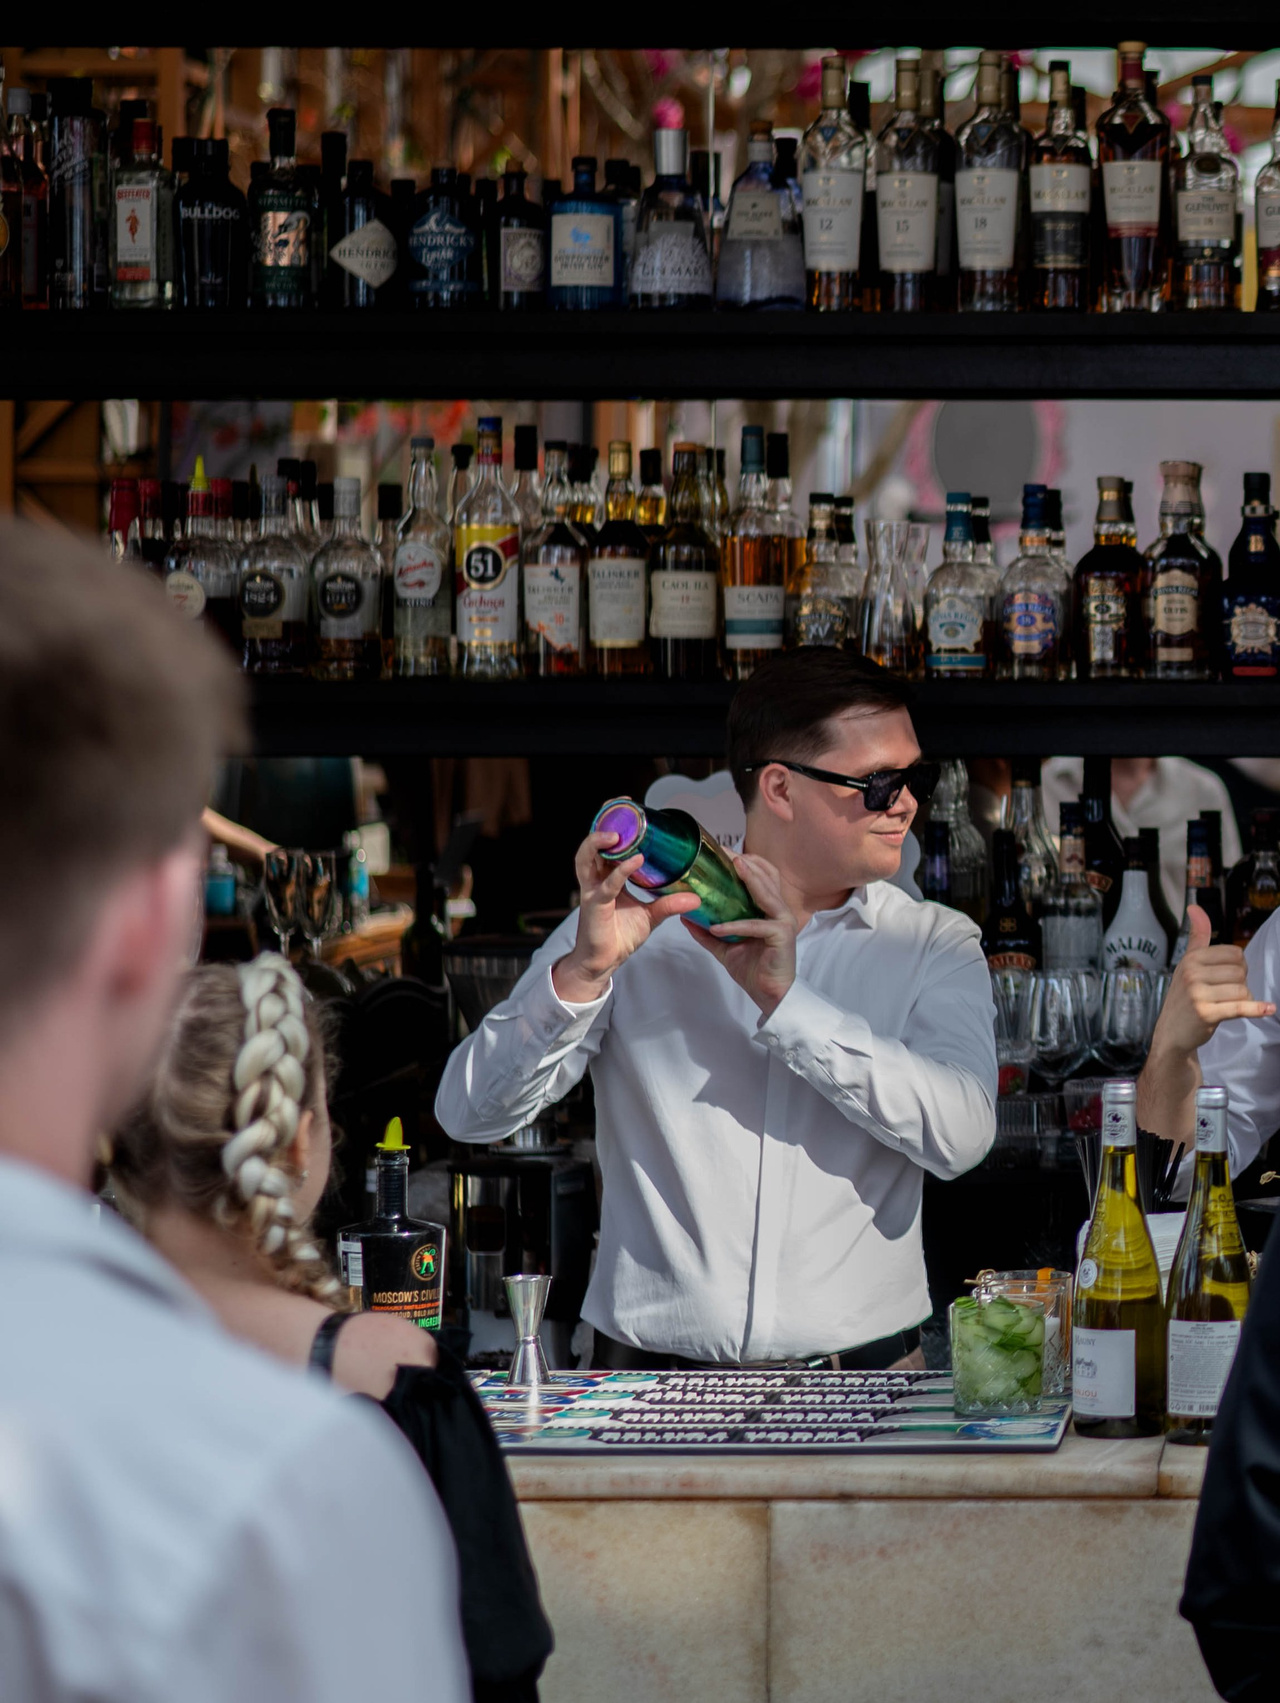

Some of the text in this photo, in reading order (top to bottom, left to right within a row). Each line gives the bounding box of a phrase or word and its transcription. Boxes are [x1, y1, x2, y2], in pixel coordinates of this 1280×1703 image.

[181, 205, 240, 220] BULLDOG
[819, 218, 834, 231] 12
[895, 219, 910, 232] 15
[974, 217, 988, 230] 18
[470, 552, 496, 579] 51
[738, 592, 782, 604] SCAPA
[808, 622, 831, 639] XV
[1105, 936, 1159, 959] MALIBU
[373, 1290, 419, 1304] MOSCOW'S
